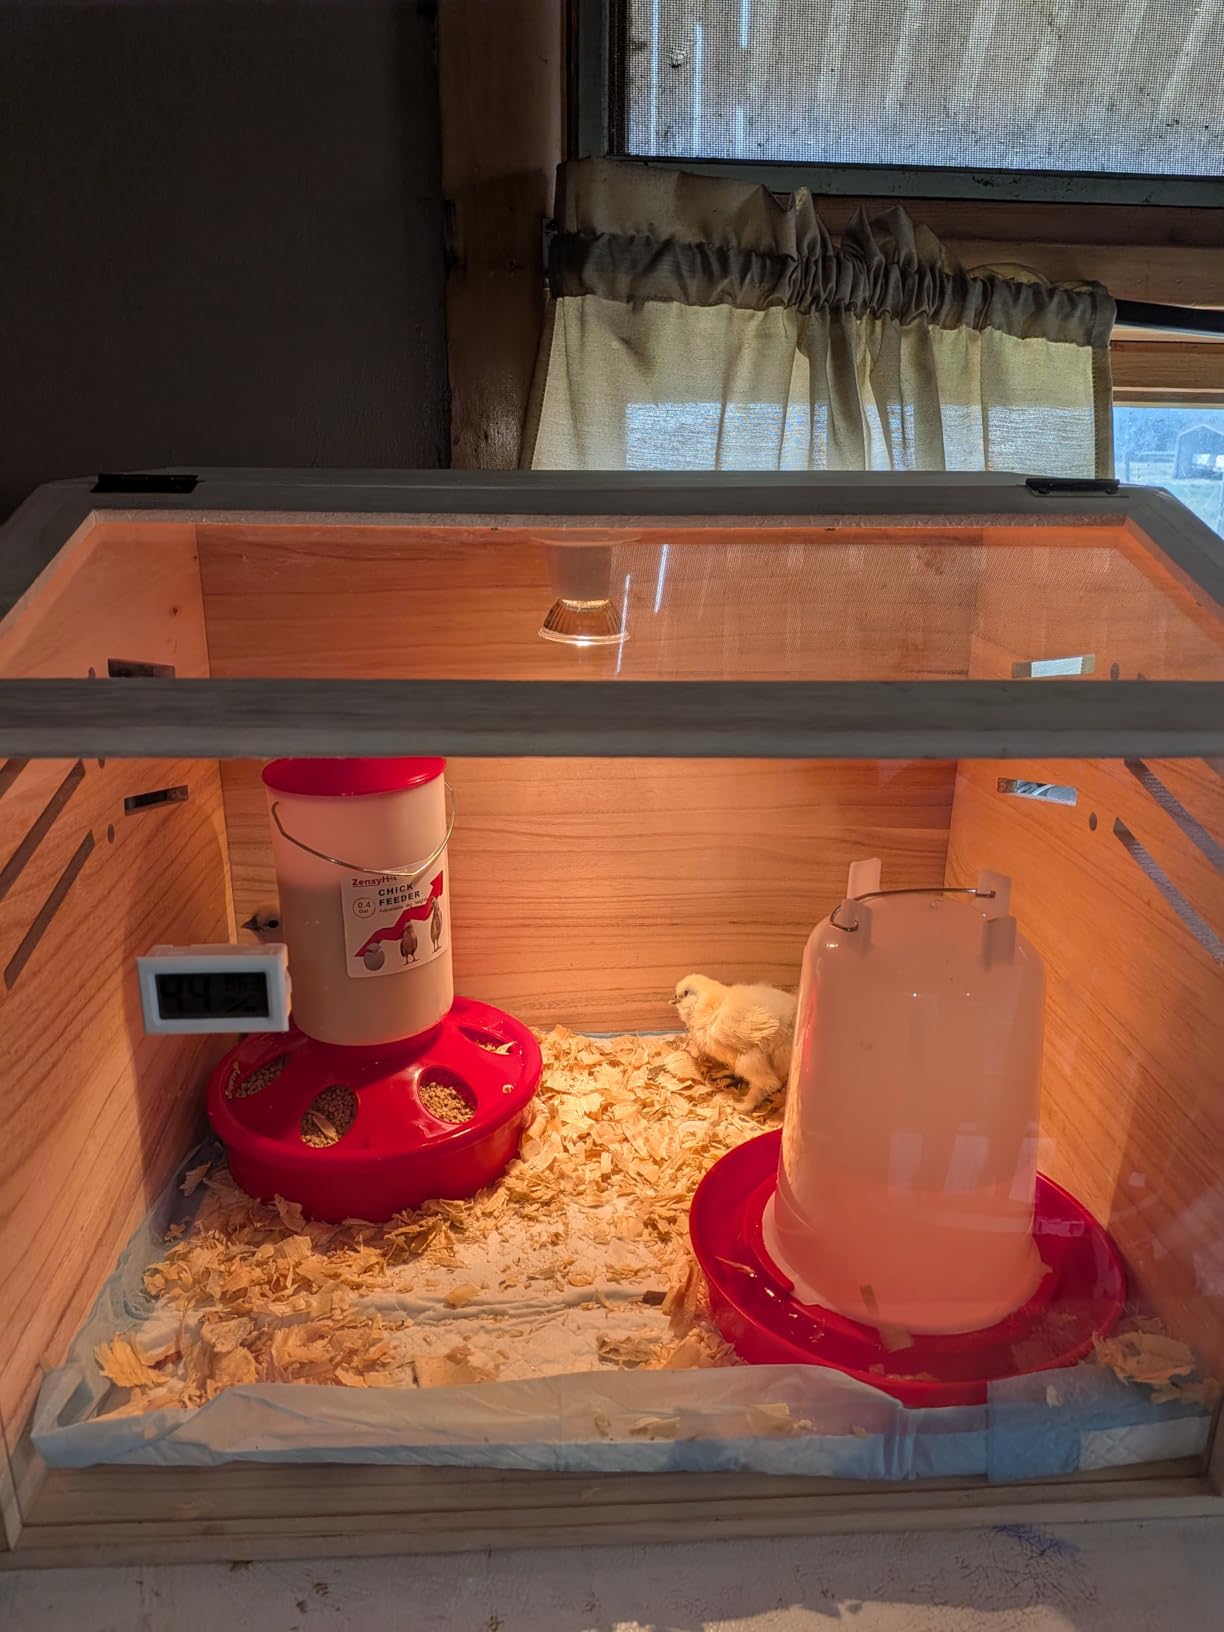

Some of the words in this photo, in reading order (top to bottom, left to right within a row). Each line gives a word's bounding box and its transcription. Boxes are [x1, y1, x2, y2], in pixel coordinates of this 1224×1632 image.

[378, 883, 414, 896] CHICK
[357, 901, 371, 909] 0.4
[379, 891, 420, 906] FEEDER
